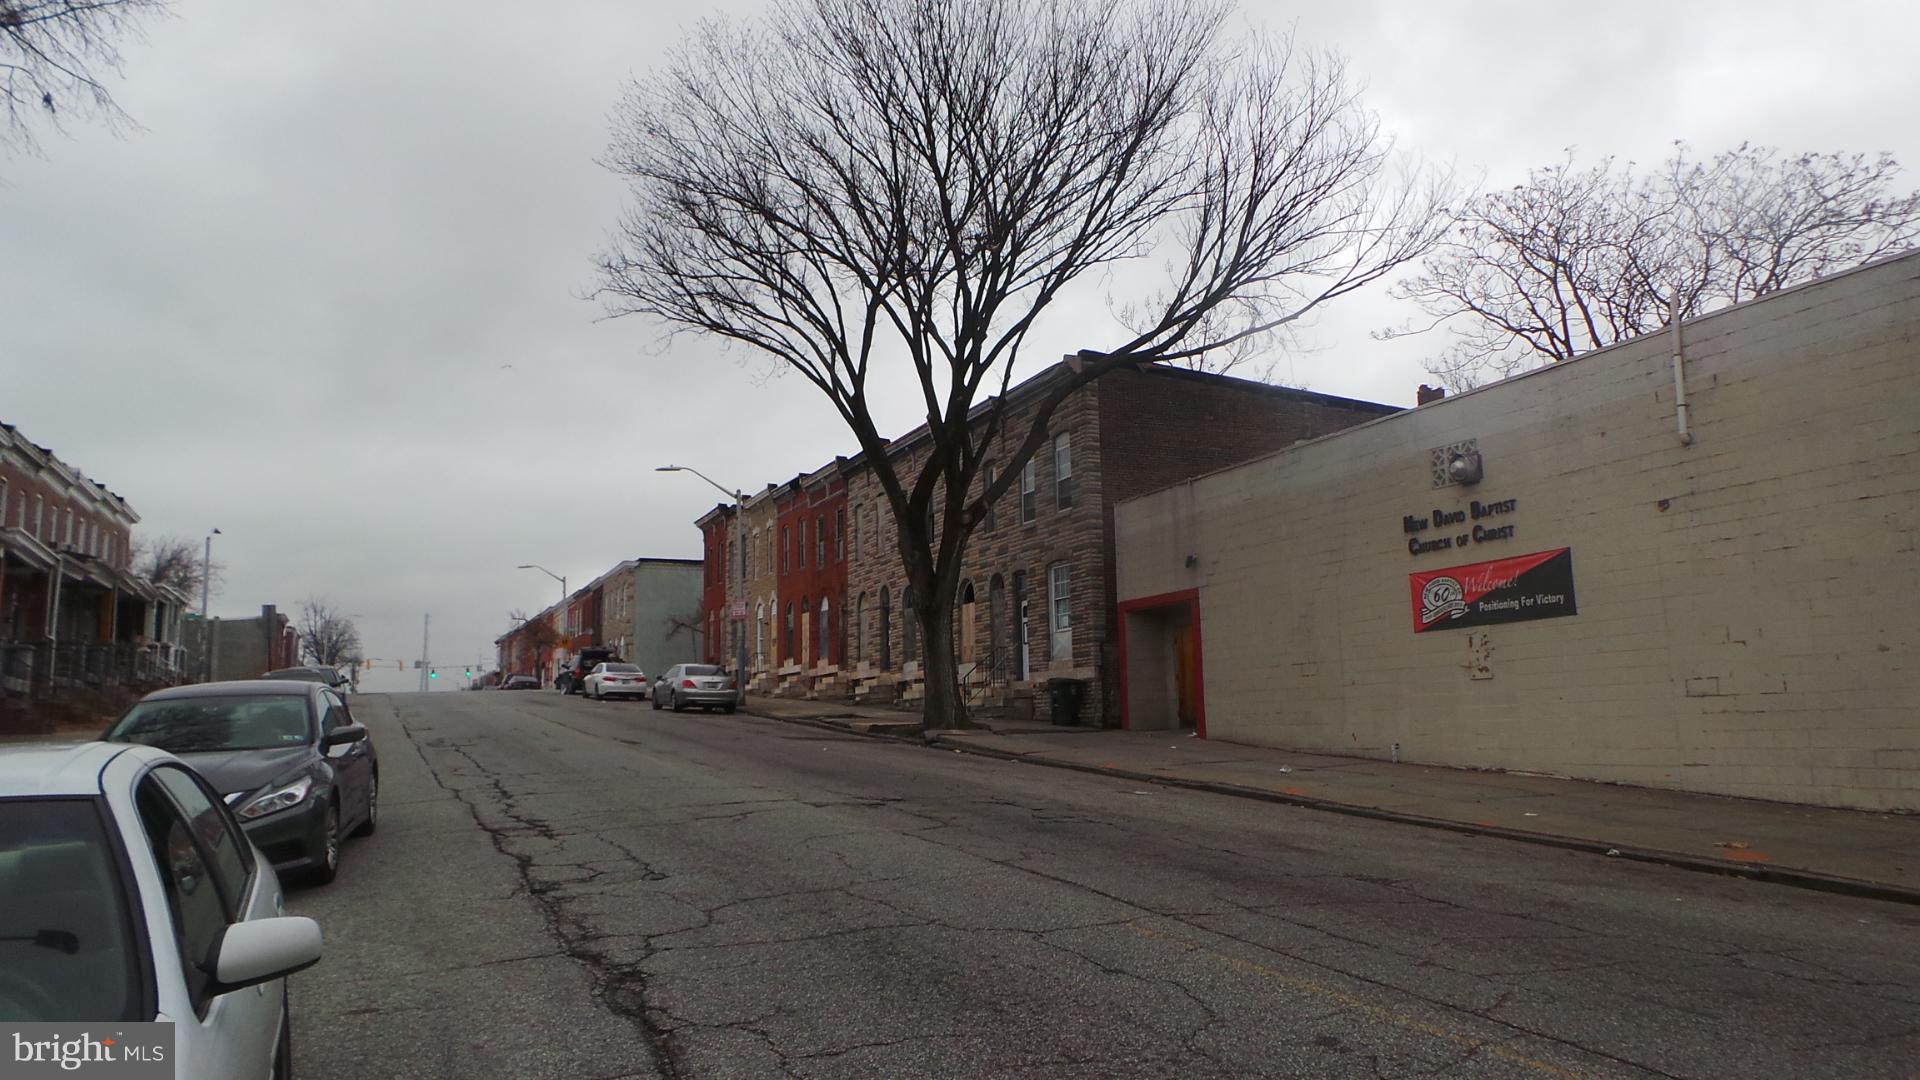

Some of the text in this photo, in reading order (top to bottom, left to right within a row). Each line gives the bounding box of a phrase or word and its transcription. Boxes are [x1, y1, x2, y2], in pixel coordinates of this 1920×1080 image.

[1464, 565, 1520, 594] Welcome!
[1479, 598, 1519, 612] Positioning
[1520, 596, 1534, 607] For
[1536, 593, 1564, 605] Victory
